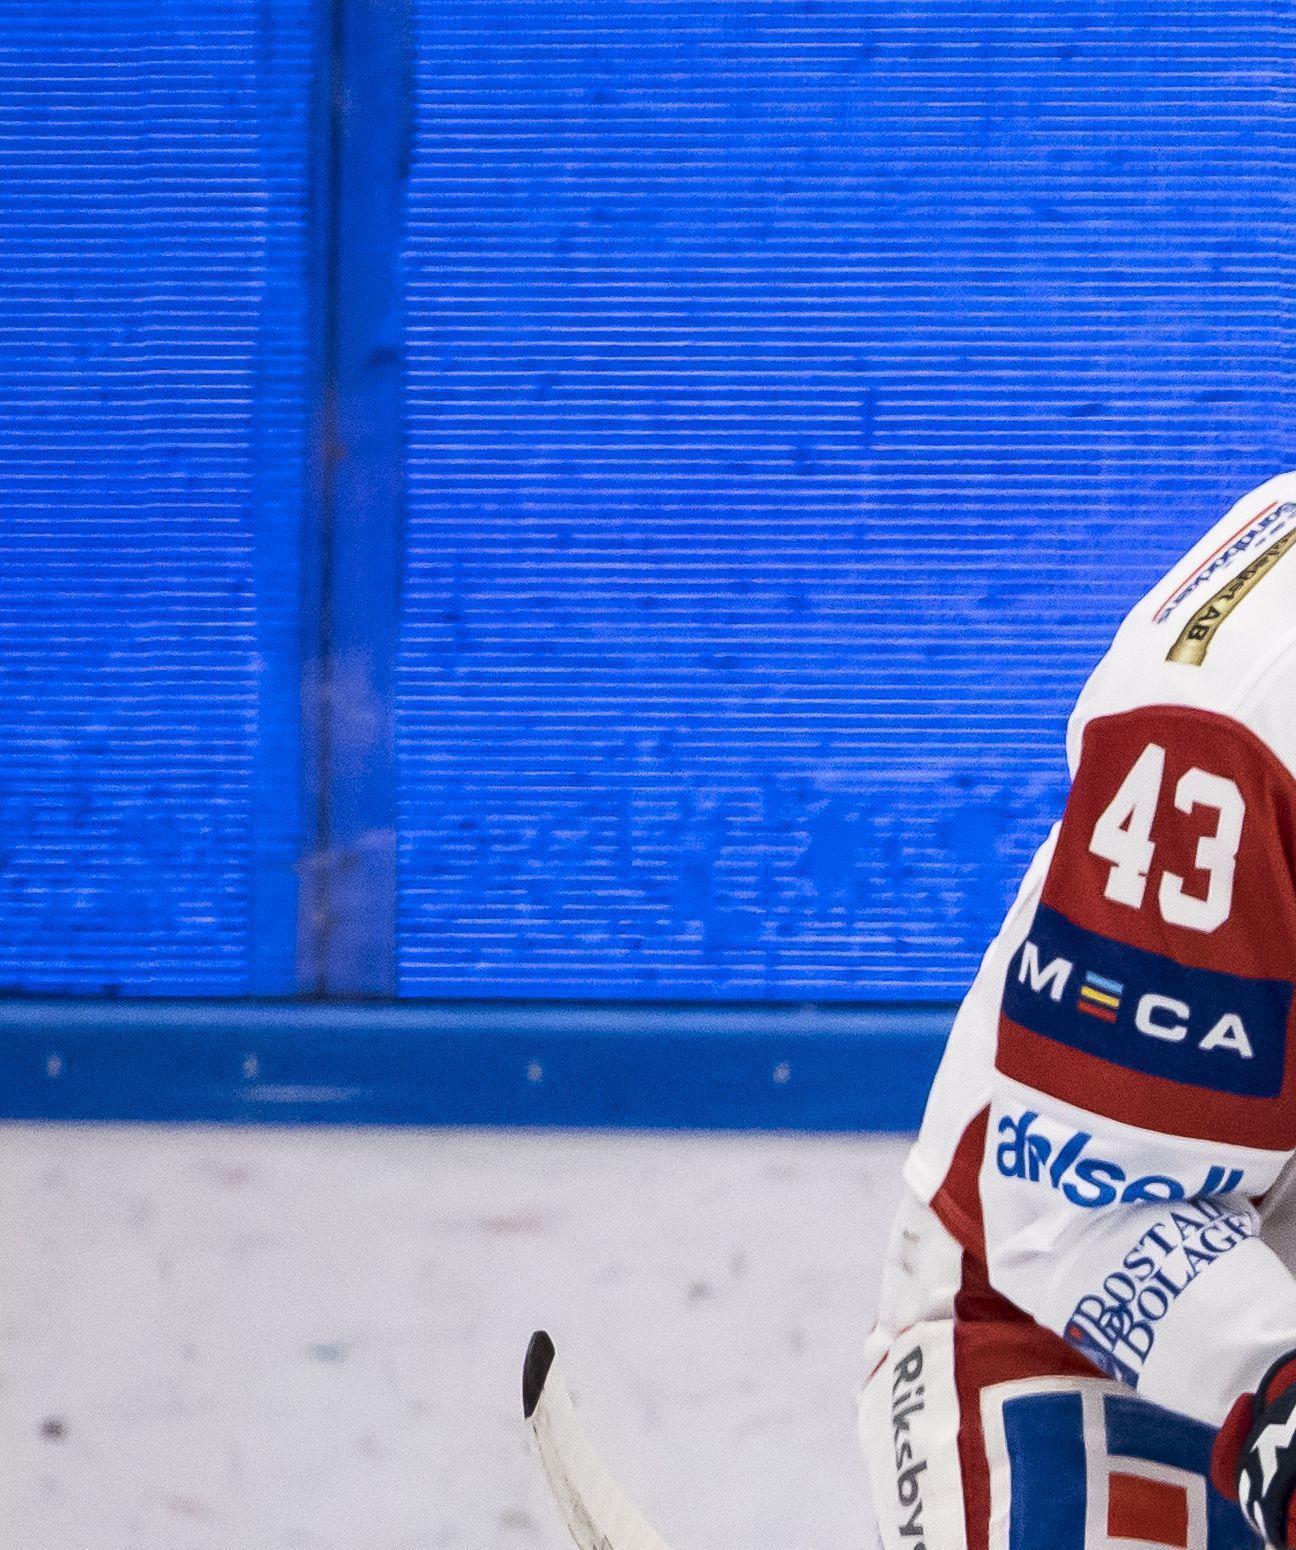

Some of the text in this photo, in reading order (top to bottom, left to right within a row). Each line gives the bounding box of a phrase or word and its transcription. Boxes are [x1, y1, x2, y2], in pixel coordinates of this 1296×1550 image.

[1188, 605, 1222, 641] AB
[1088, 742, 1246, 934] 43
[892, 1345, 927, 1550] Riksby
